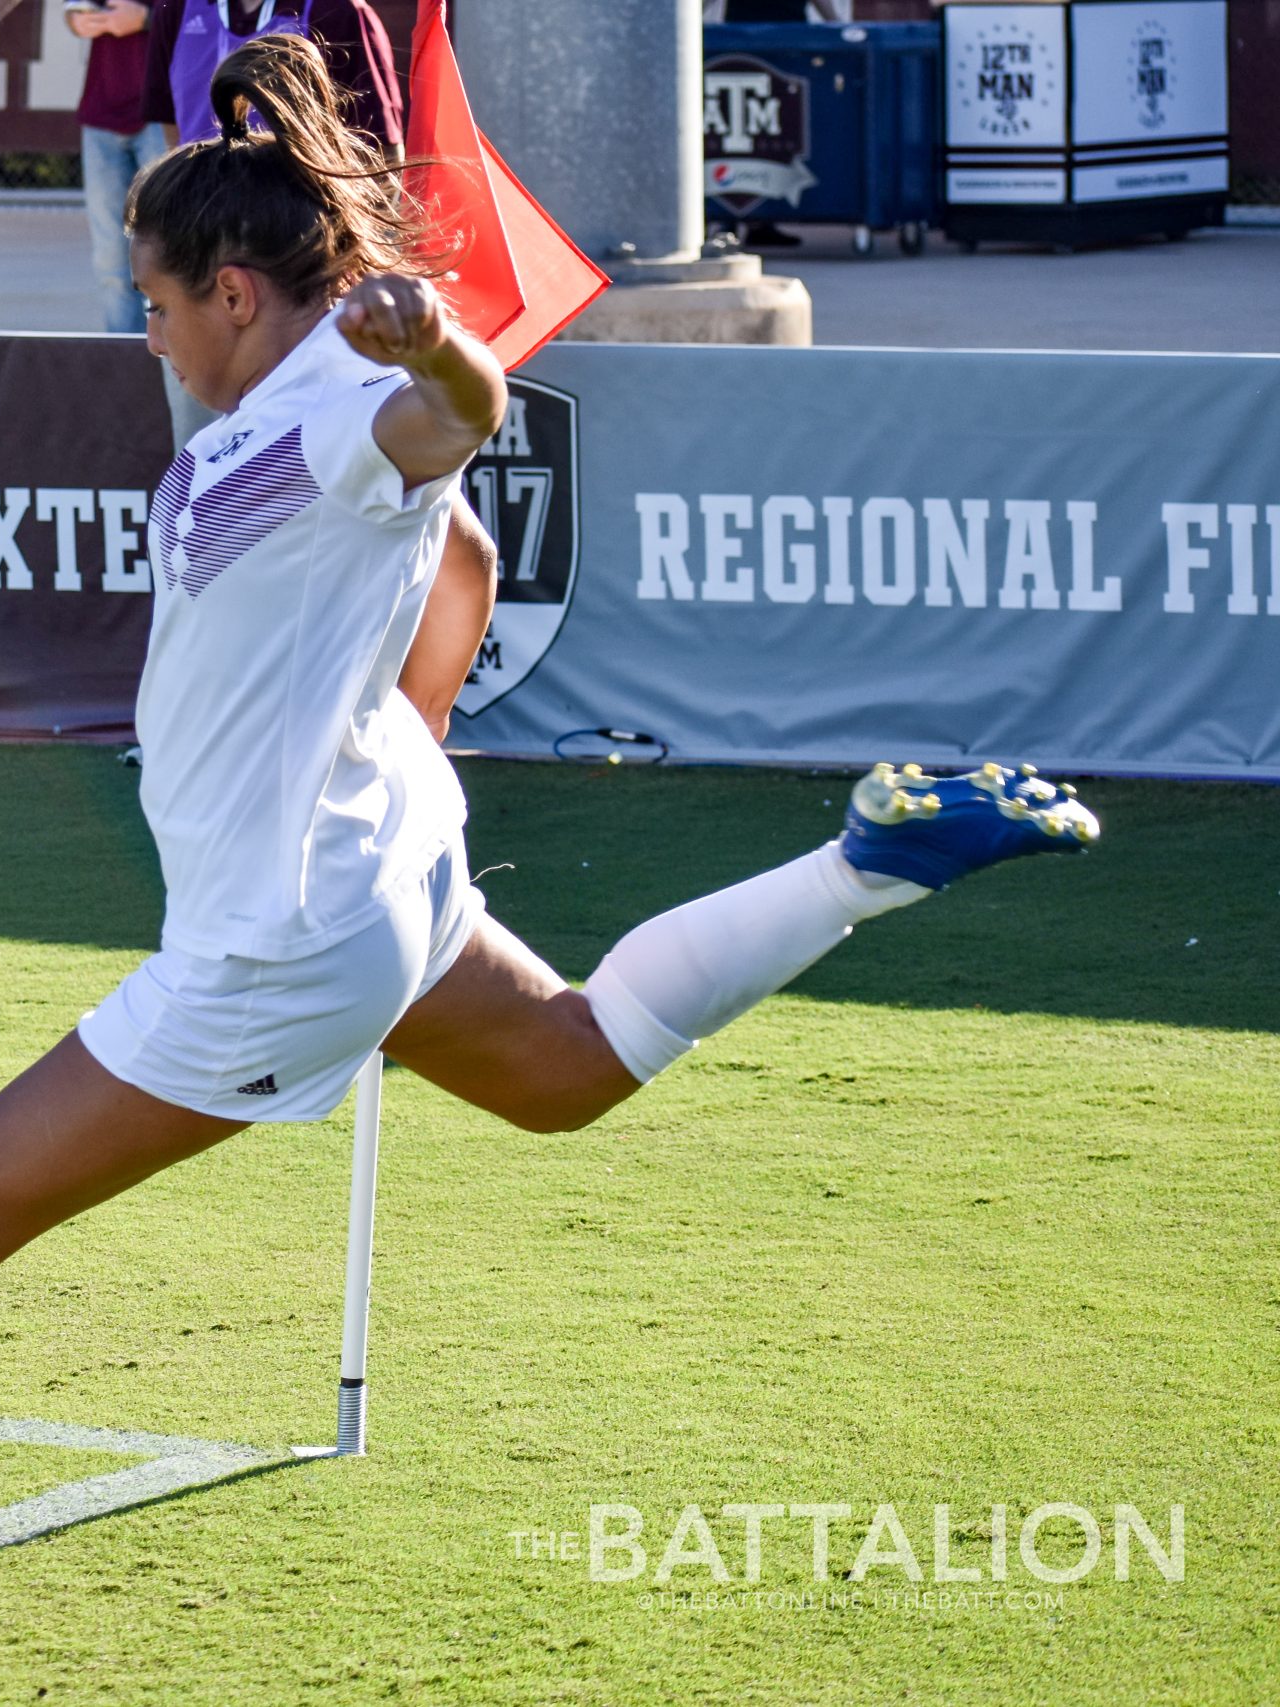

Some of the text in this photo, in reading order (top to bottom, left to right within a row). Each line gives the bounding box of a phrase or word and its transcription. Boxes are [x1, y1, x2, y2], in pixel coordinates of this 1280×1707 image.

[977, 73, 1035, 101] MAN
[634, 493, 1280, 616] REGIONAL FI
